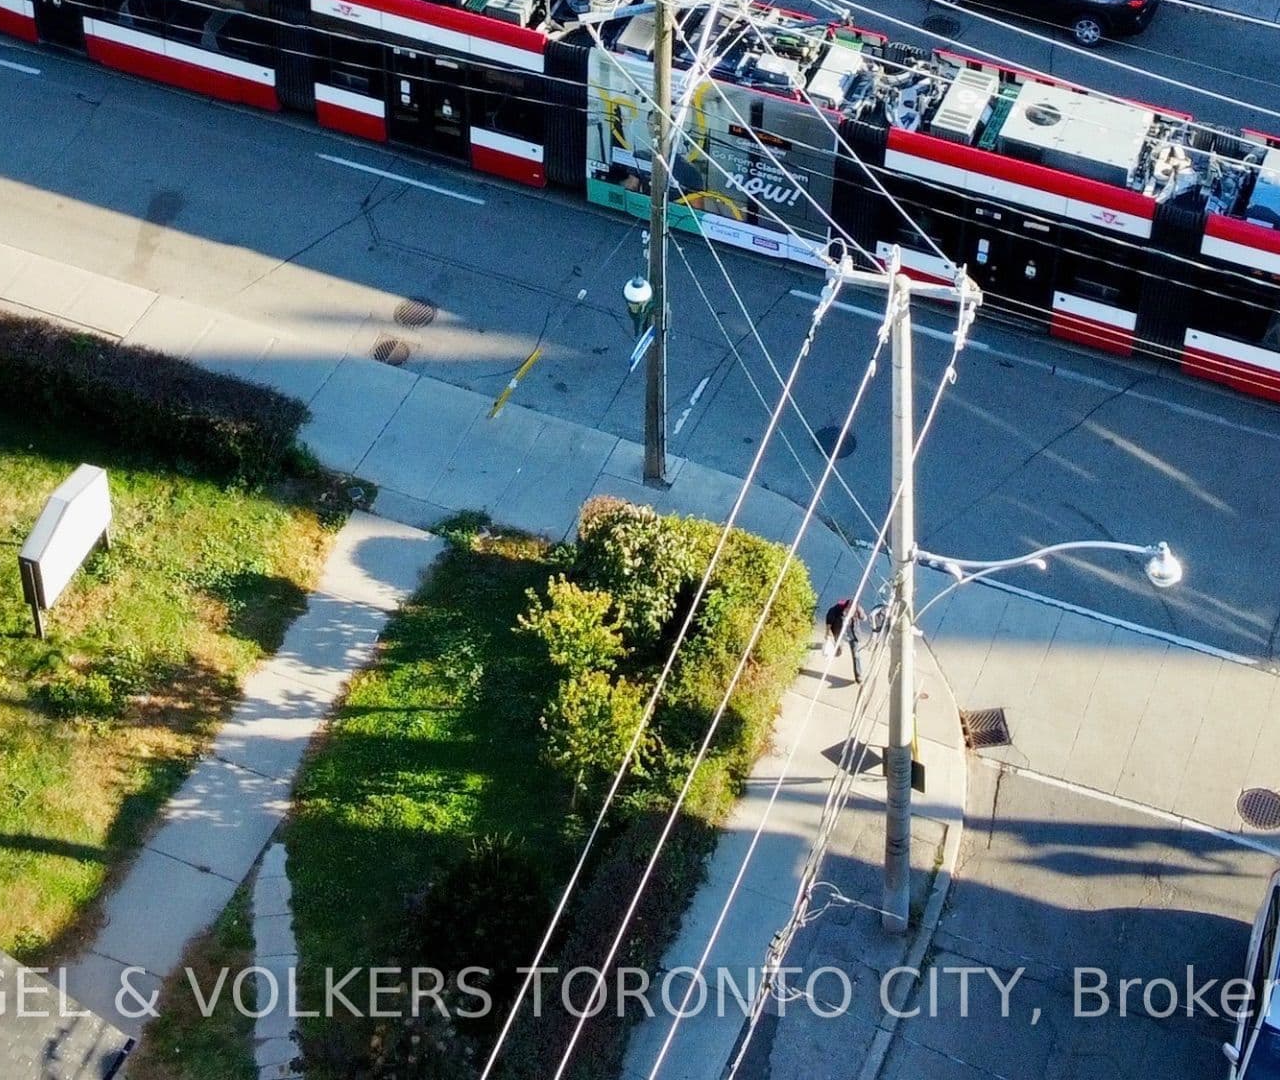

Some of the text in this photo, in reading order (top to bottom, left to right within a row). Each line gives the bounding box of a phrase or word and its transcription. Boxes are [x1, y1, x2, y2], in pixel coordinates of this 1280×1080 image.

[711, 150, 726, 160] Go
[728, 153, 754, 168] From
[735, 163, 749, 174] To
